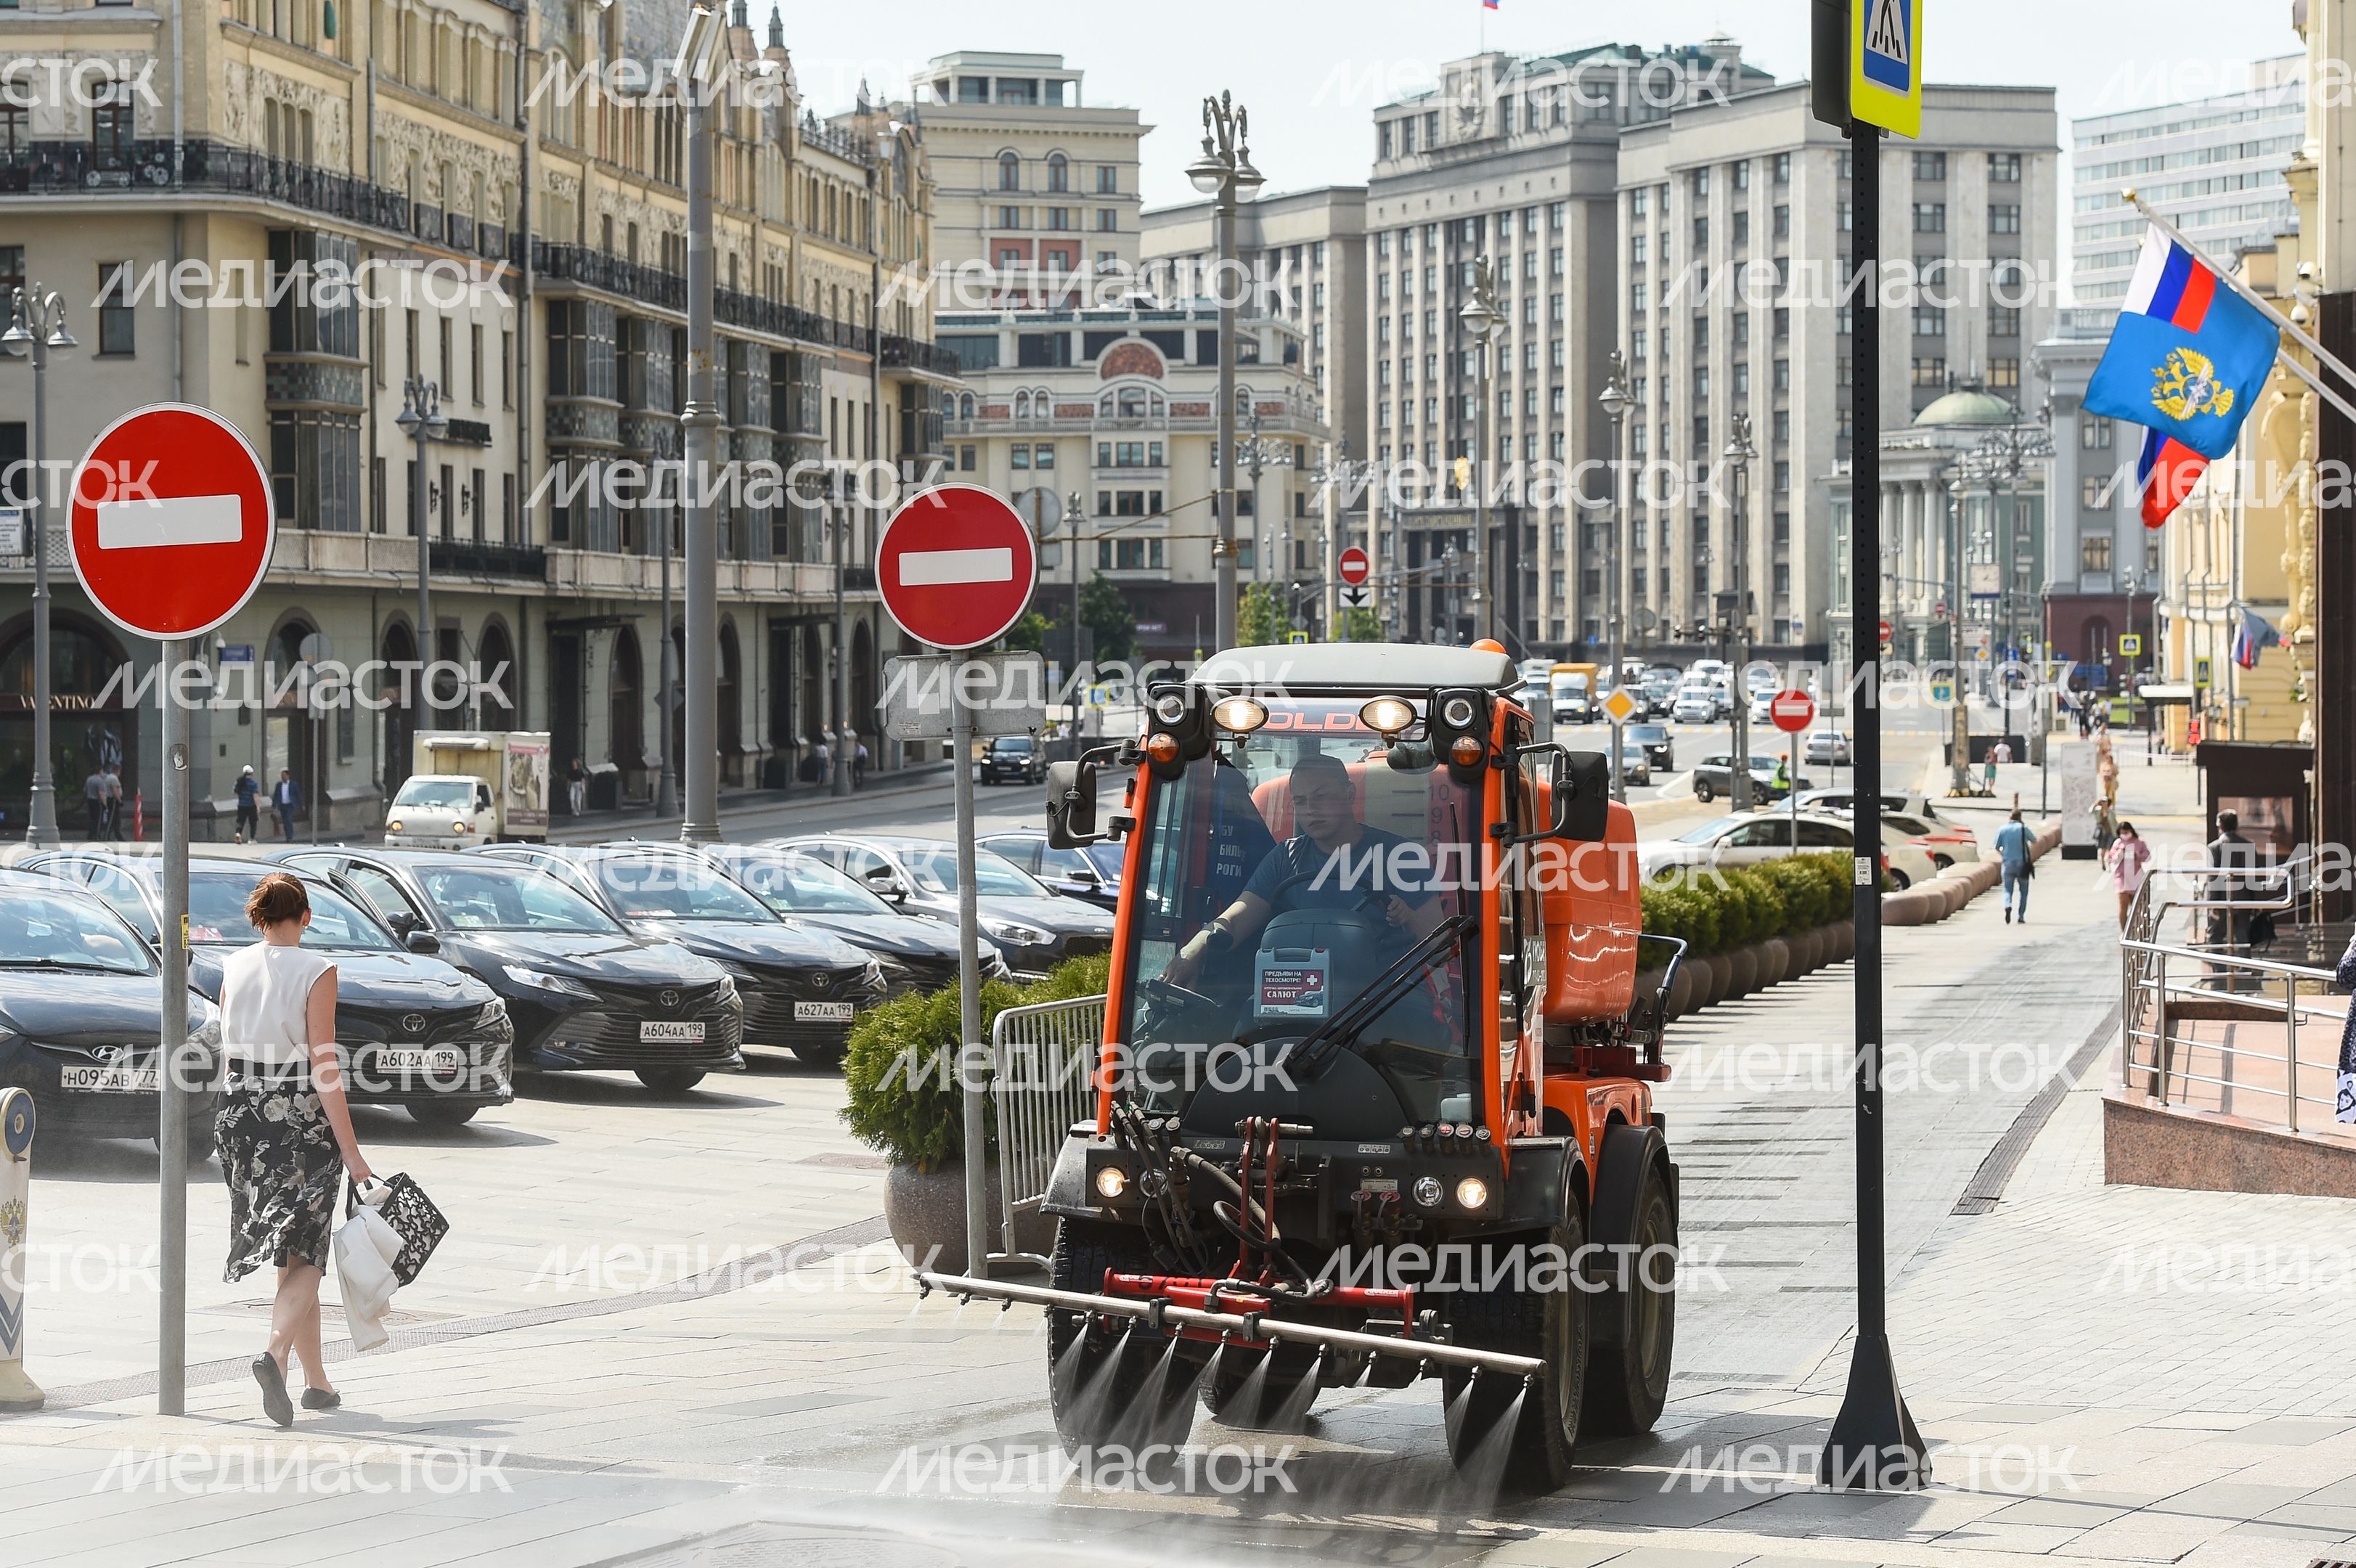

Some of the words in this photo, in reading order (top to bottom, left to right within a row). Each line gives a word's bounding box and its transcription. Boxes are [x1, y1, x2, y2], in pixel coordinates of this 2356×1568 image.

[20, 695, 95, 709] VAENTINO
[1429, 784, 1449, 801] 10
[1431, 807, 1443, 824] 9
[837, 1004, 851, 1013] 199
[644, 1024, 685, 1037] А604АА
[687, 1024, 703, 1034] 199
[380, 1052, 431, 1066] А602АА
[434, 1052, 454, 1063] 199
[134, 1070, 156, 1082] 777
